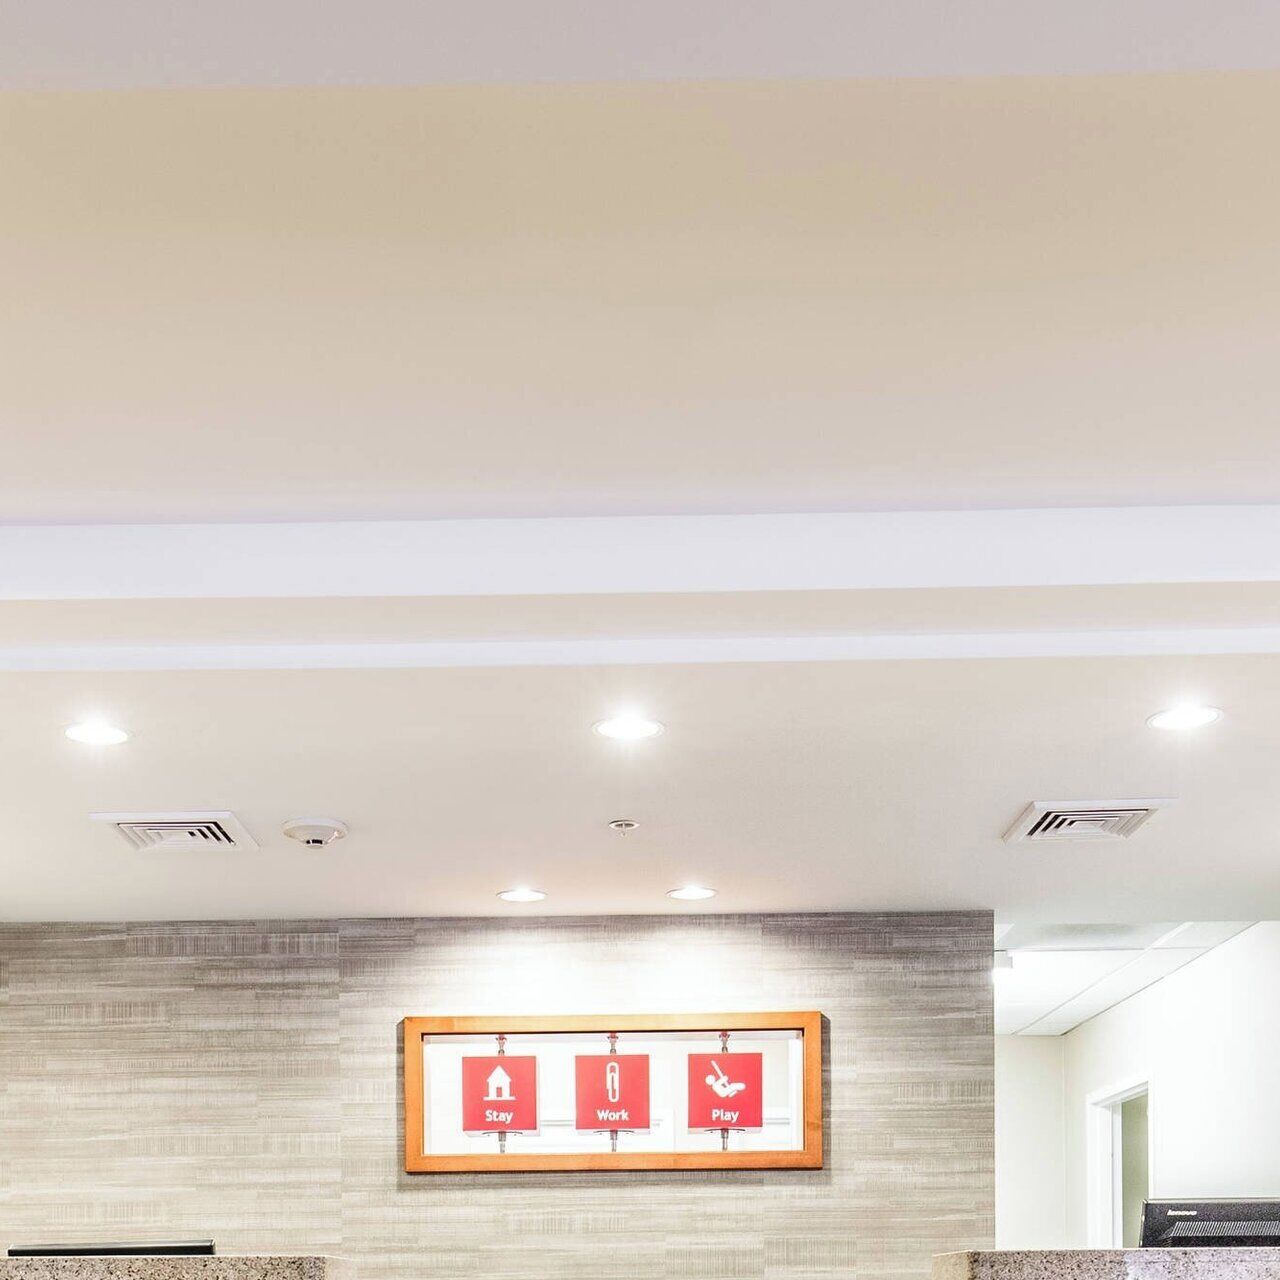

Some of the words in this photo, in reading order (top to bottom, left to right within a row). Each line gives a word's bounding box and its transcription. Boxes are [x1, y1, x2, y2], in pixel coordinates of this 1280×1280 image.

[485, 1109, 514, 1124] Stay
[596, 1109, 629, 1122] Work
[712, 1108, 740, 1124] Play
